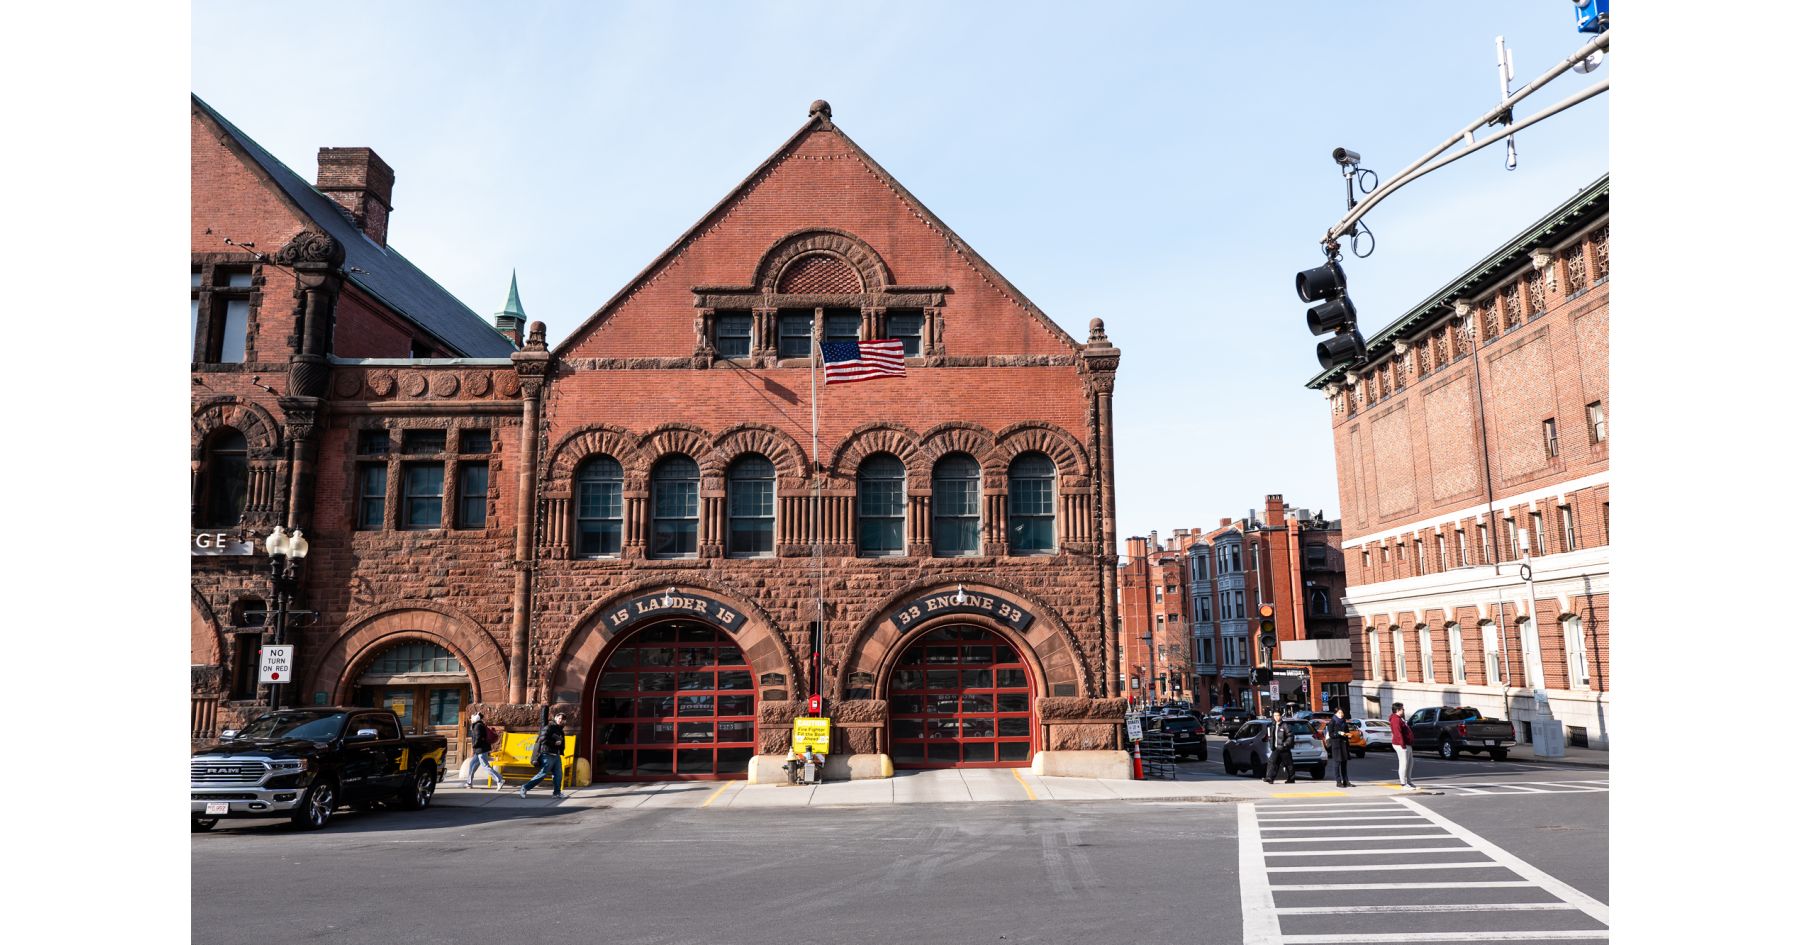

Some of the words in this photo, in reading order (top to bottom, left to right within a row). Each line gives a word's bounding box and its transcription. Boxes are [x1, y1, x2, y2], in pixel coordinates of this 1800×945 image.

[610, 608, 630, 626] 15
[715, 607, 736, 624] 15
[898, 606, 921, 624] 33
[925, 595, 994, 611] ENGINE
[998, 604, 1022, 622] 33
